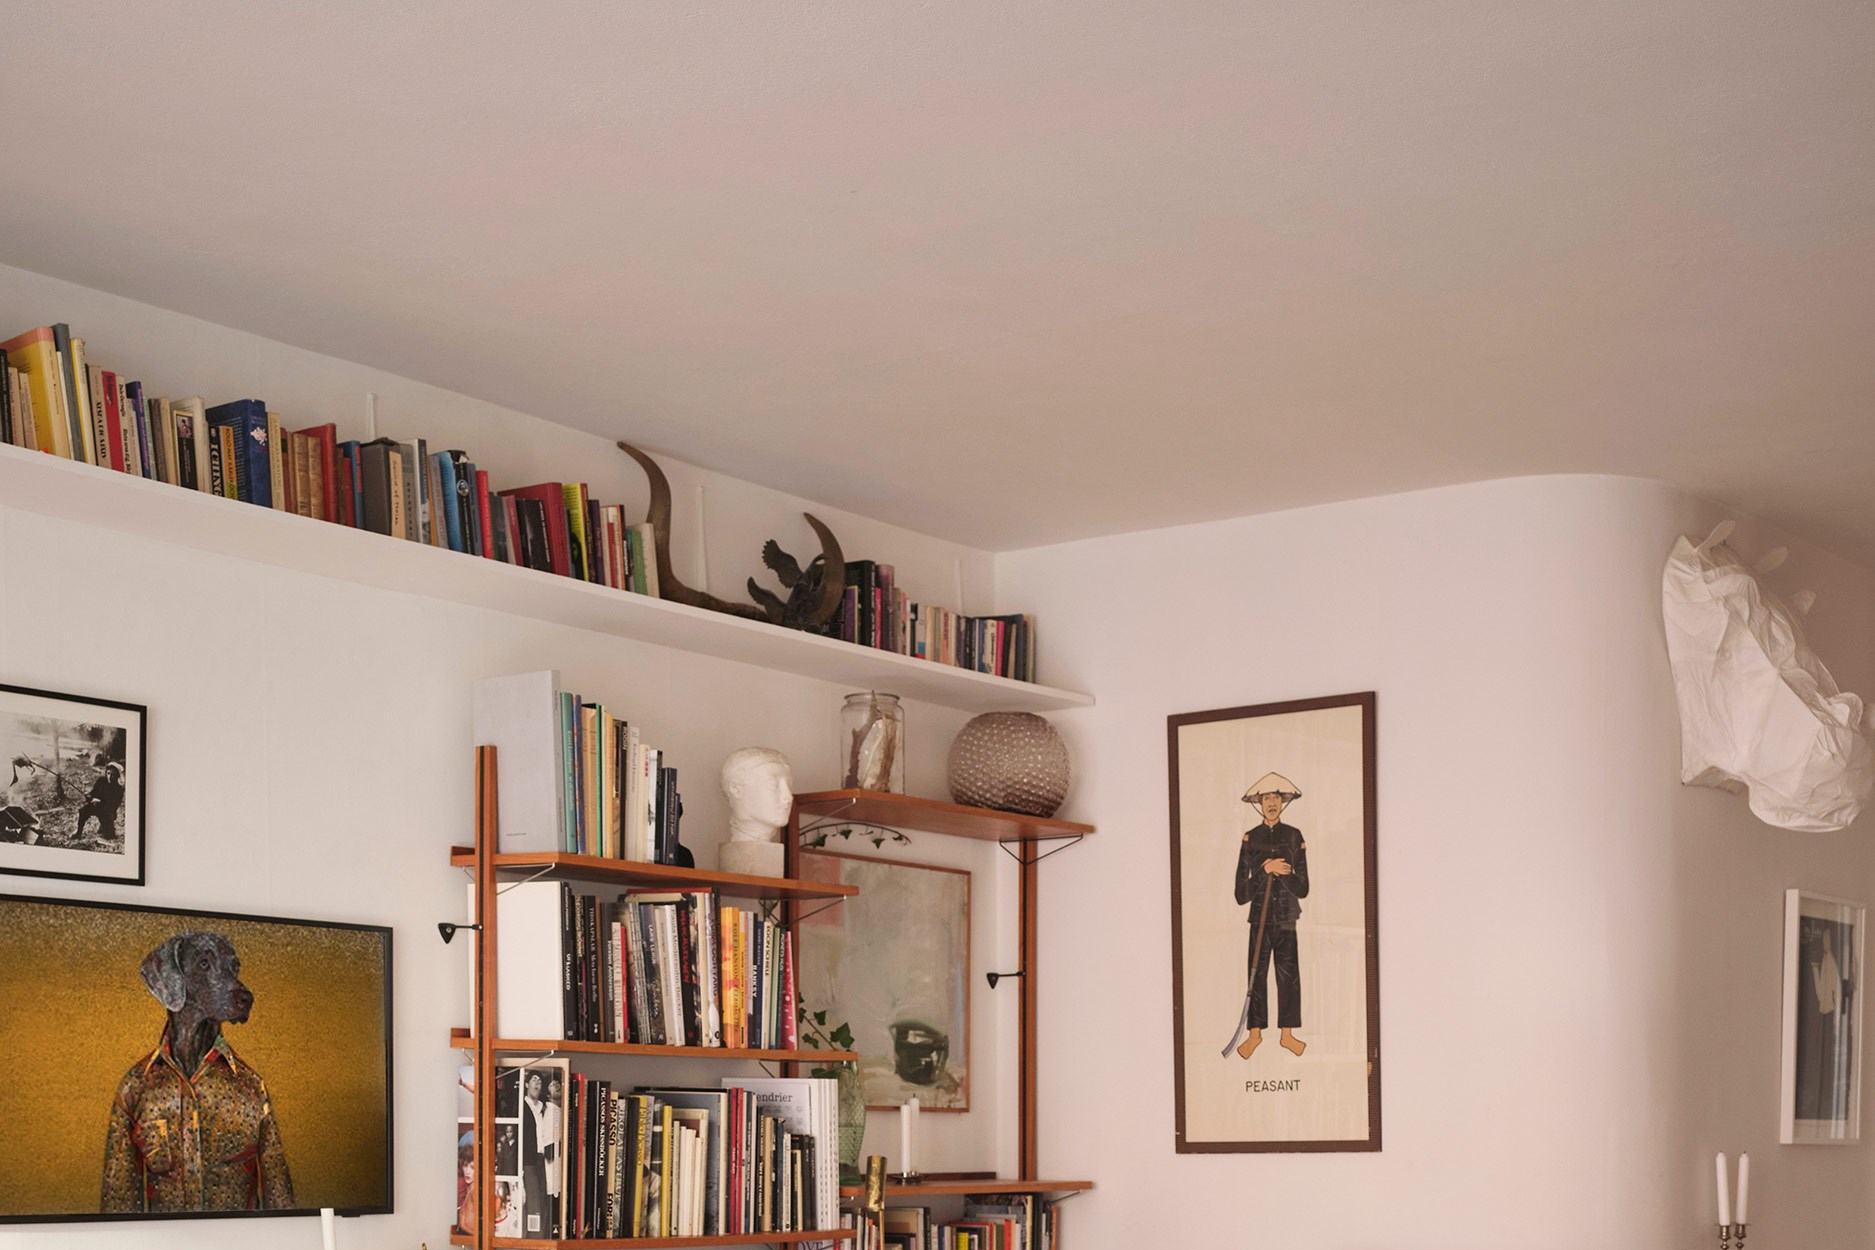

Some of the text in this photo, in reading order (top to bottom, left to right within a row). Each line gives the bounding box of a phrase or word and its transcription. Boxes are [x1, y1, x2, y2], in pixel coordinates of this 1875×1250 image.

[607, 965, 615, 1001] Andersson
[672, 935, 682, 1017] Modersohn-Becker
[1245, 1079, 1301, 1093] PEASANT
[598, 1087, 608, 1177] PICASSOS SKISSBÖCKER
[608, 1098, 618, 1146] PICASSO
[636, 1106, 647, 1166] Pablo Picasso
